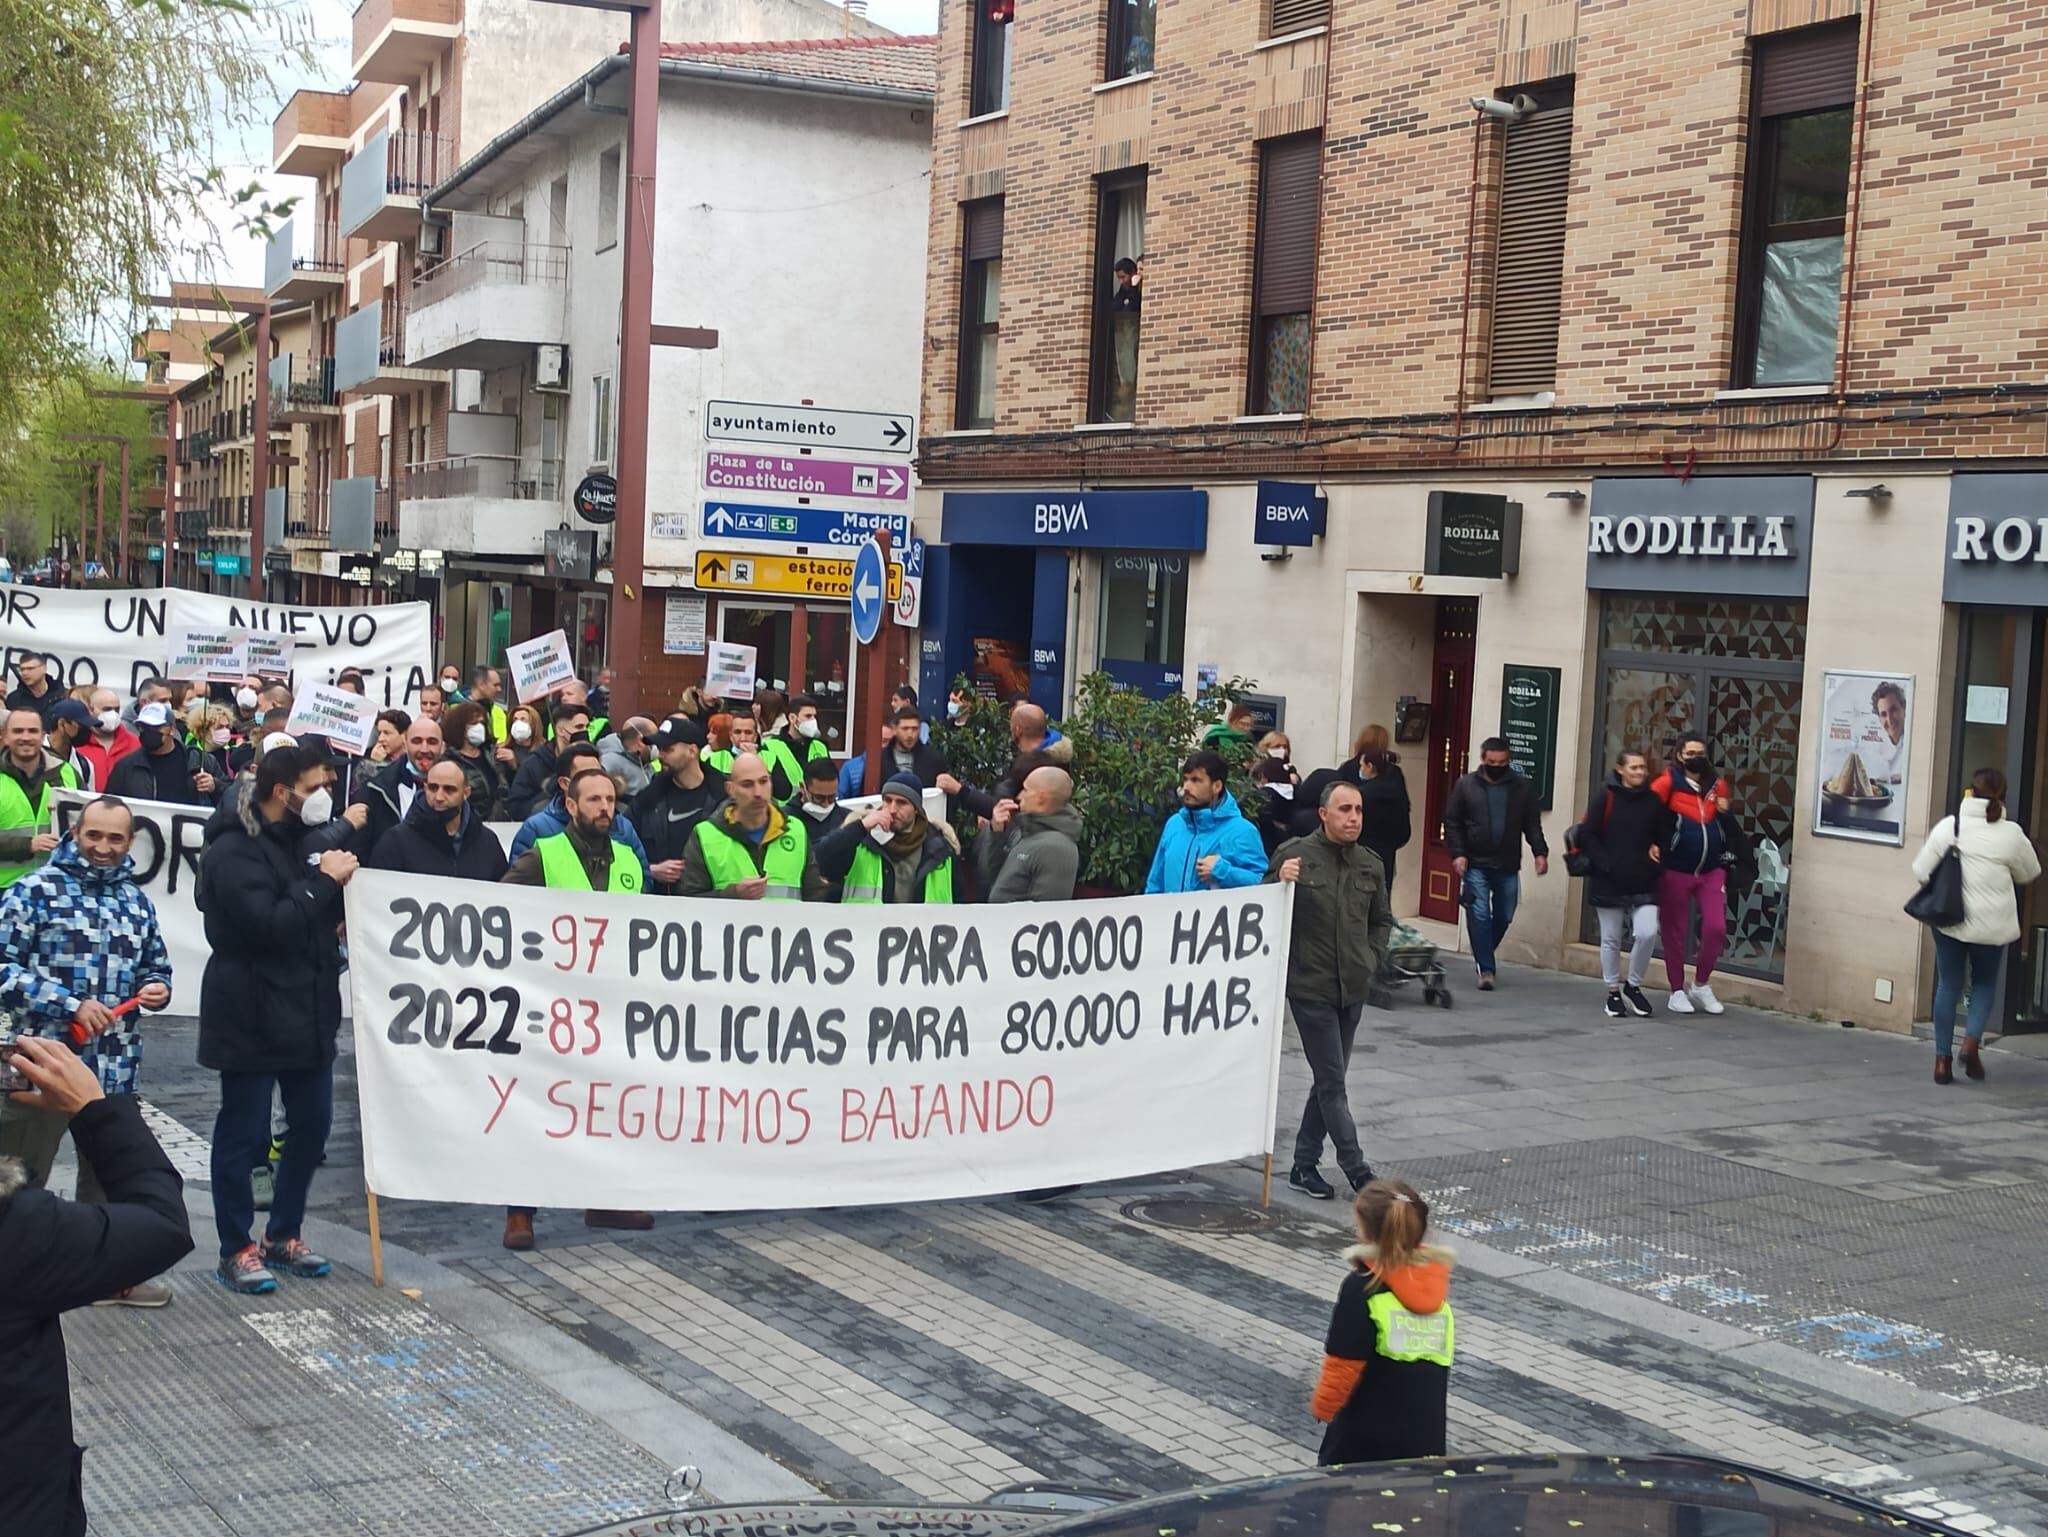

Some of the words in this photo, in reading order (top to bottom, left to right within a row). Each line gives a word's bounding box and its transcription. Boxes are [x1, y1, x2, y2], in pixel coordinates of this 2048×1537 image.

[713, 416, 836, 436] ayuntamiento
[710, 454, 747, 468] Plaza
[755, 458, 773, 470] de
[781, 459, 794, 471] la
[709, 469, 826, 492] Constitución
[738, 515, 764, 529] A-4
[843, 512, 904, 531] Madrid
[1034, 500, 1089, 534] BBVA
[1266, 505, 1309, 522] BBVA
[828, 528, 902, 547] Córda
[1444, 526, 1500, 541] RODILLA
[1589, 516, 1789, 557] RODILLA
[788, 561, 853, 577] estació
[104, 598, 166, 637] UN
[923, 639, 942, 653] BBVA
[1034, 649, 1057, 663] BBVA
[628, 918, 855, 985] POLICIAS
[877, 923, 988, 986] PARA
[1010, 914, 1143, 980] 60.000
[1170, 902, 1270, 965] HAB.
[625, 1000, 848, 1065] POLICIAS
[868, 1005, 969, 1065] PARA
[1000, 989, 1141, 1054] 80.000
[1163, 976, 1260, 1037] HAB.
[484, 1074, 518, 1135] Y
[545, 1079, 812, 1145] SEGUIMOS
[840, 1074, 1055, 1143] BAJANDO
